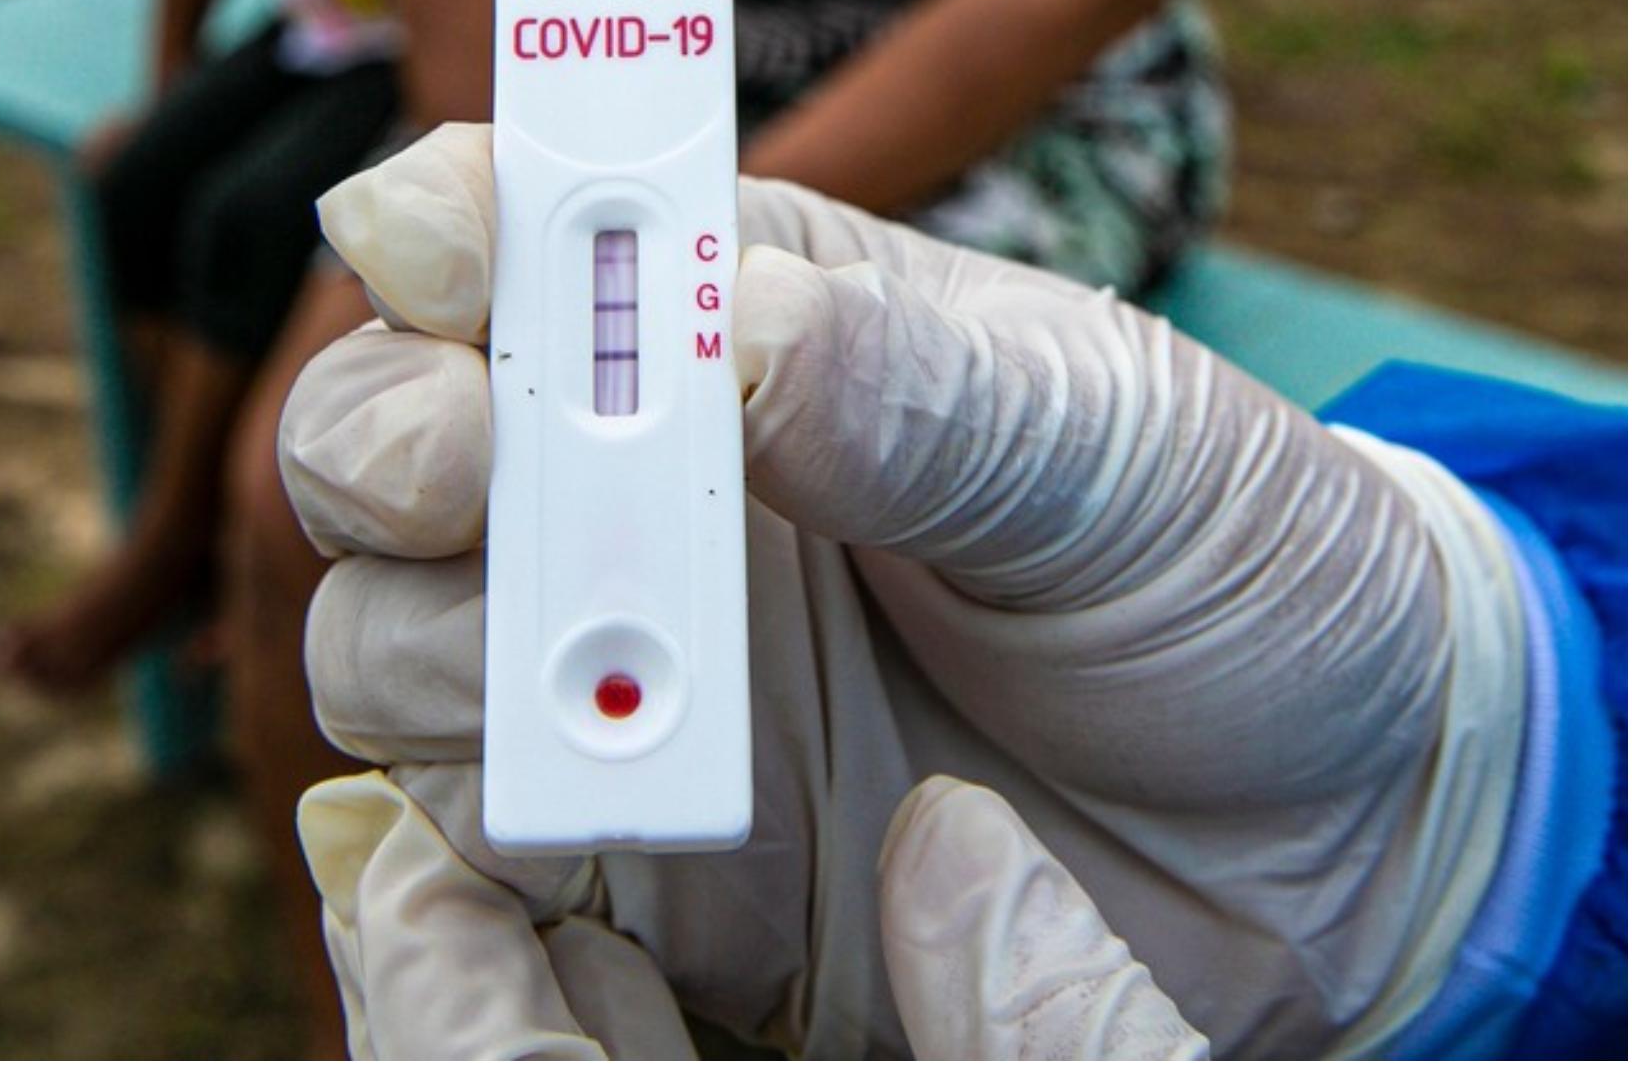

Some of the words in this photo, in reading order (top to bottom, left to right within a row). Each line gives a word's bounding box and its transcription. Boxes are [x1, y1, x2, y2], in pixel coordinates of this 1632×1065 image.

[513, 14, 715, 60] COVID-19
[695, 234, 719, 262] C
[695, 284, 719, 310] G
[695, 332, 721, 359] M
